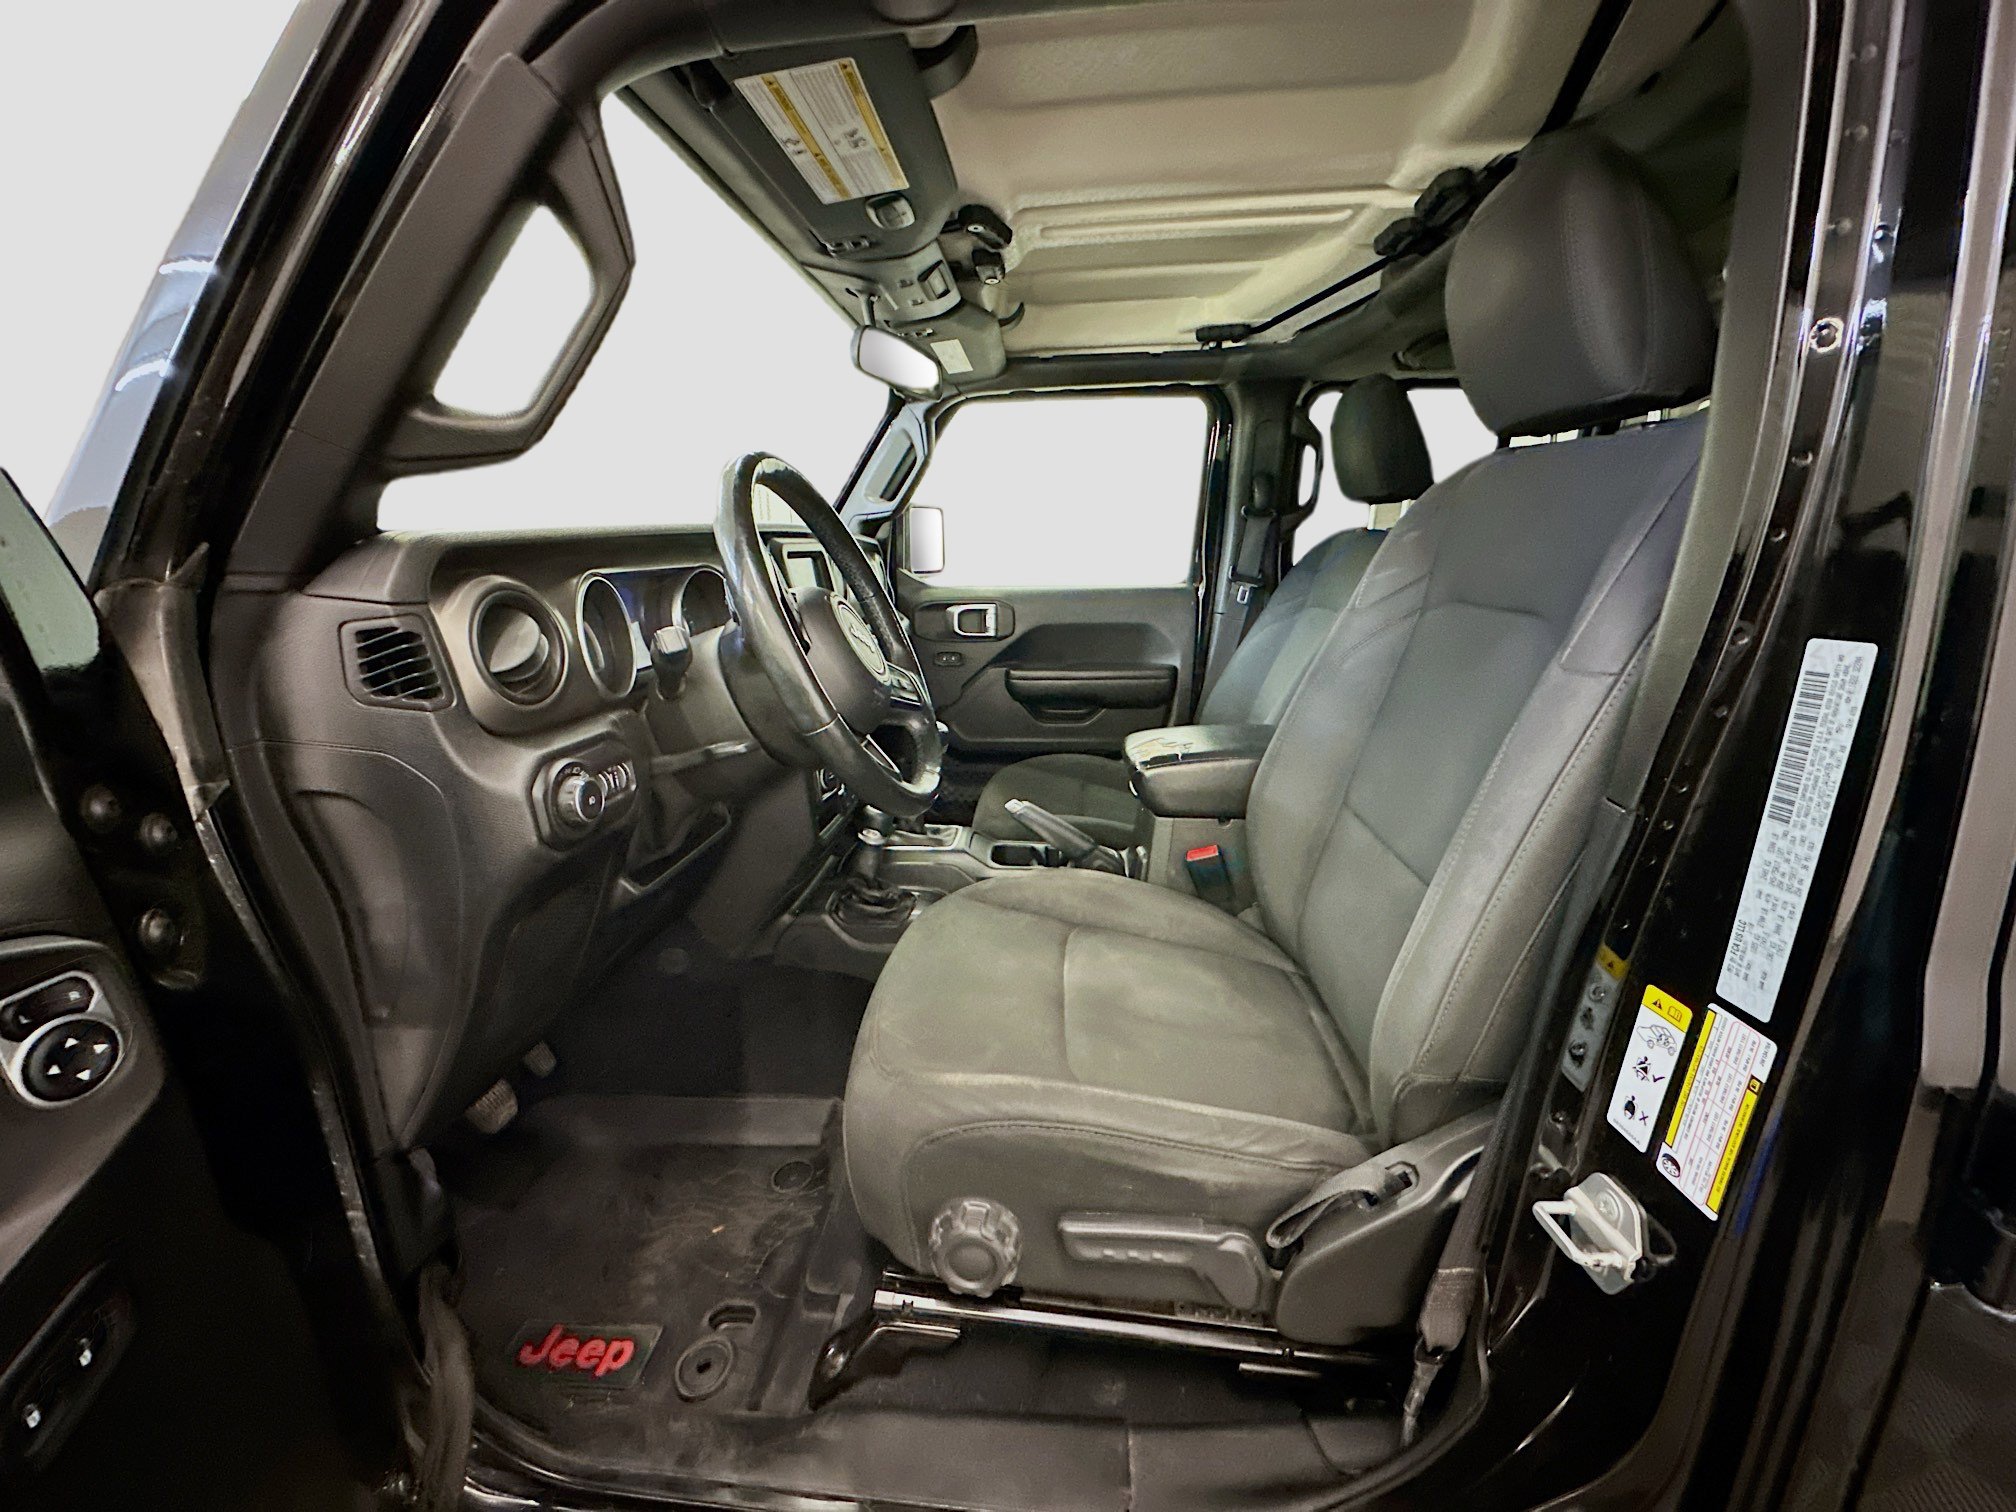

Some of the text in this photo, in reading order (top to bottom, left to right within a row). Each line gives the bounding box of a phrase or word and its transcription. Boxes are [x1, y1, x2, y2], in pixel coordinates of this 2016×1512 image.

[1737, 919, 1747, 932] LLC
[1734, 932, 1743, 943] US
[1731, 941, 1740, 956] FCA
[517, 1323, 635, 1377] Jeep
